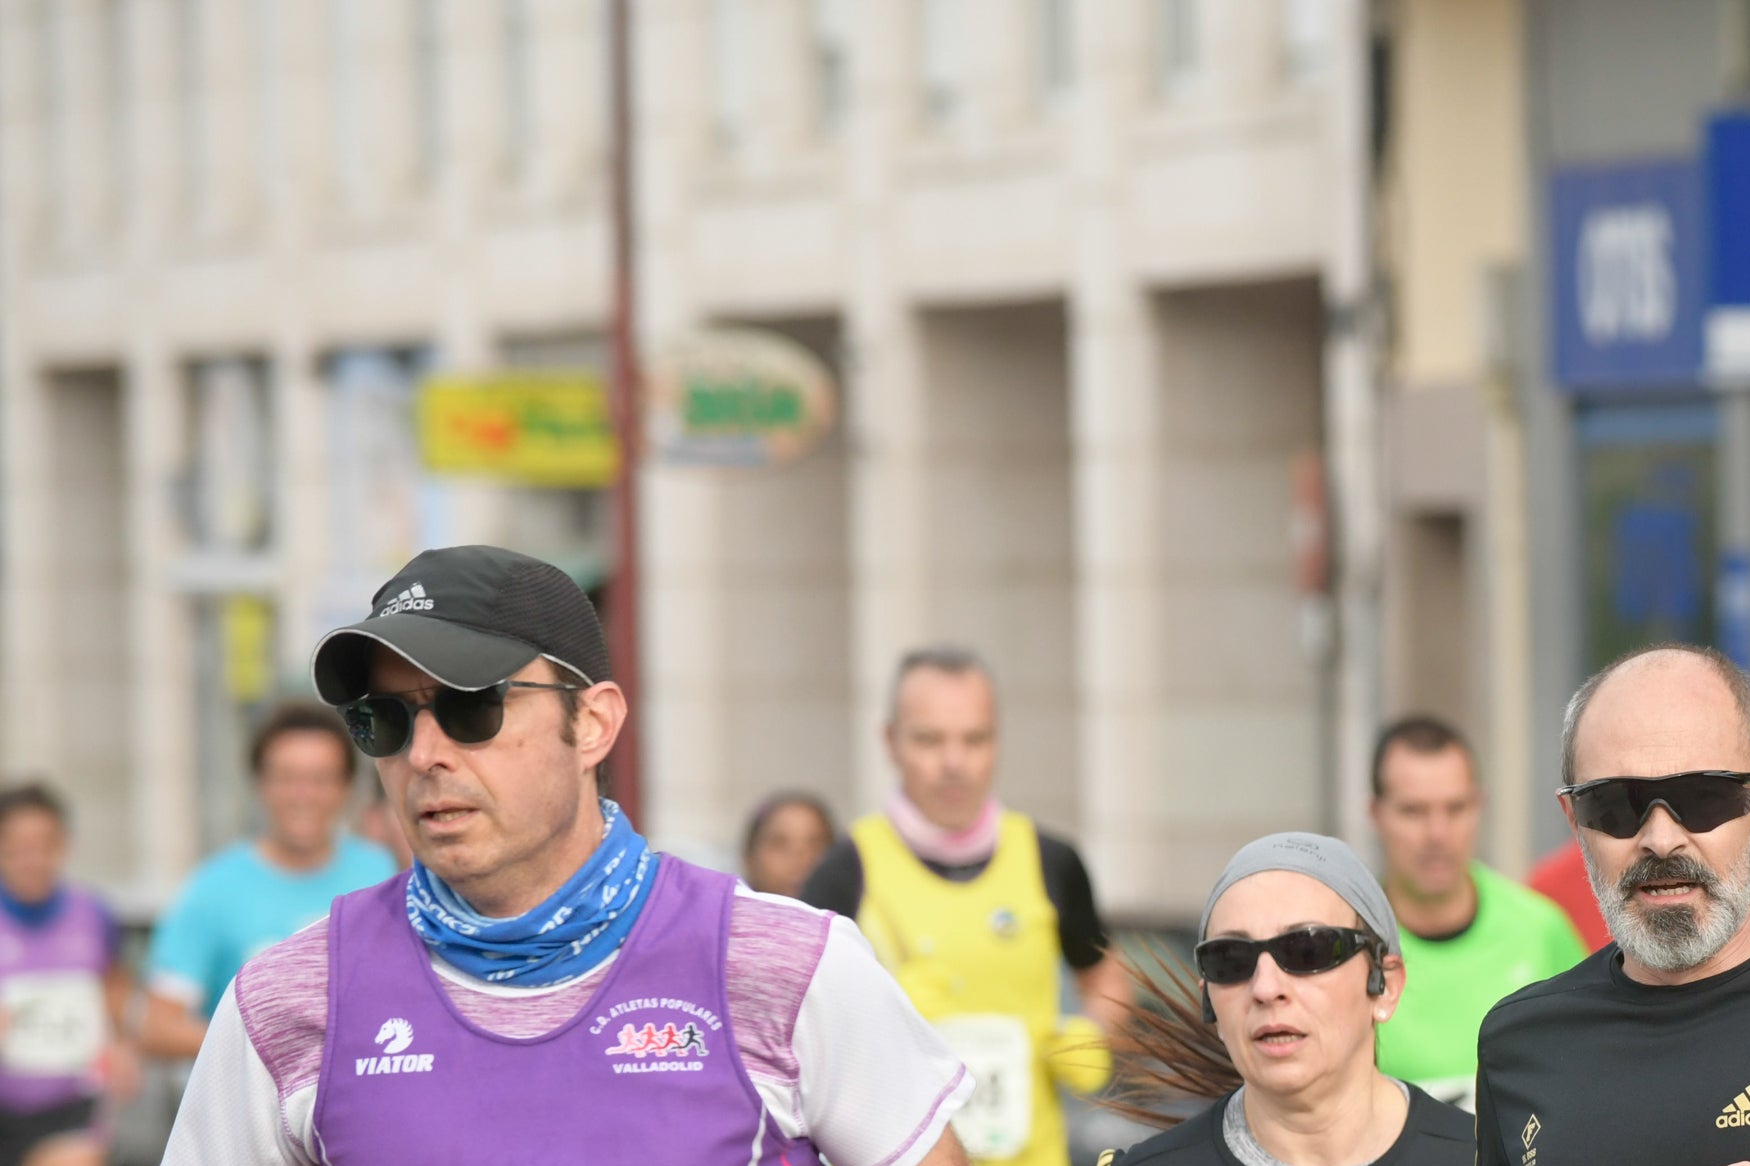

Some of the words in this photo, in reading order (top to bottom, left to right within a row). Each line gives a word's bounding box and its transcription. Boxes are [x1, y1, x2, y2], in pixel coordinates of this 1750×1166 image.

[380, 598, 434, 617] adidas
[609, 998, 659, 1018] ATLETAS
[659, 998, 723, 1031] POPULARES
[356, 1054, 434, 1076] VIATOR
[612, 1061, 704, 1074] VALLADOLID
